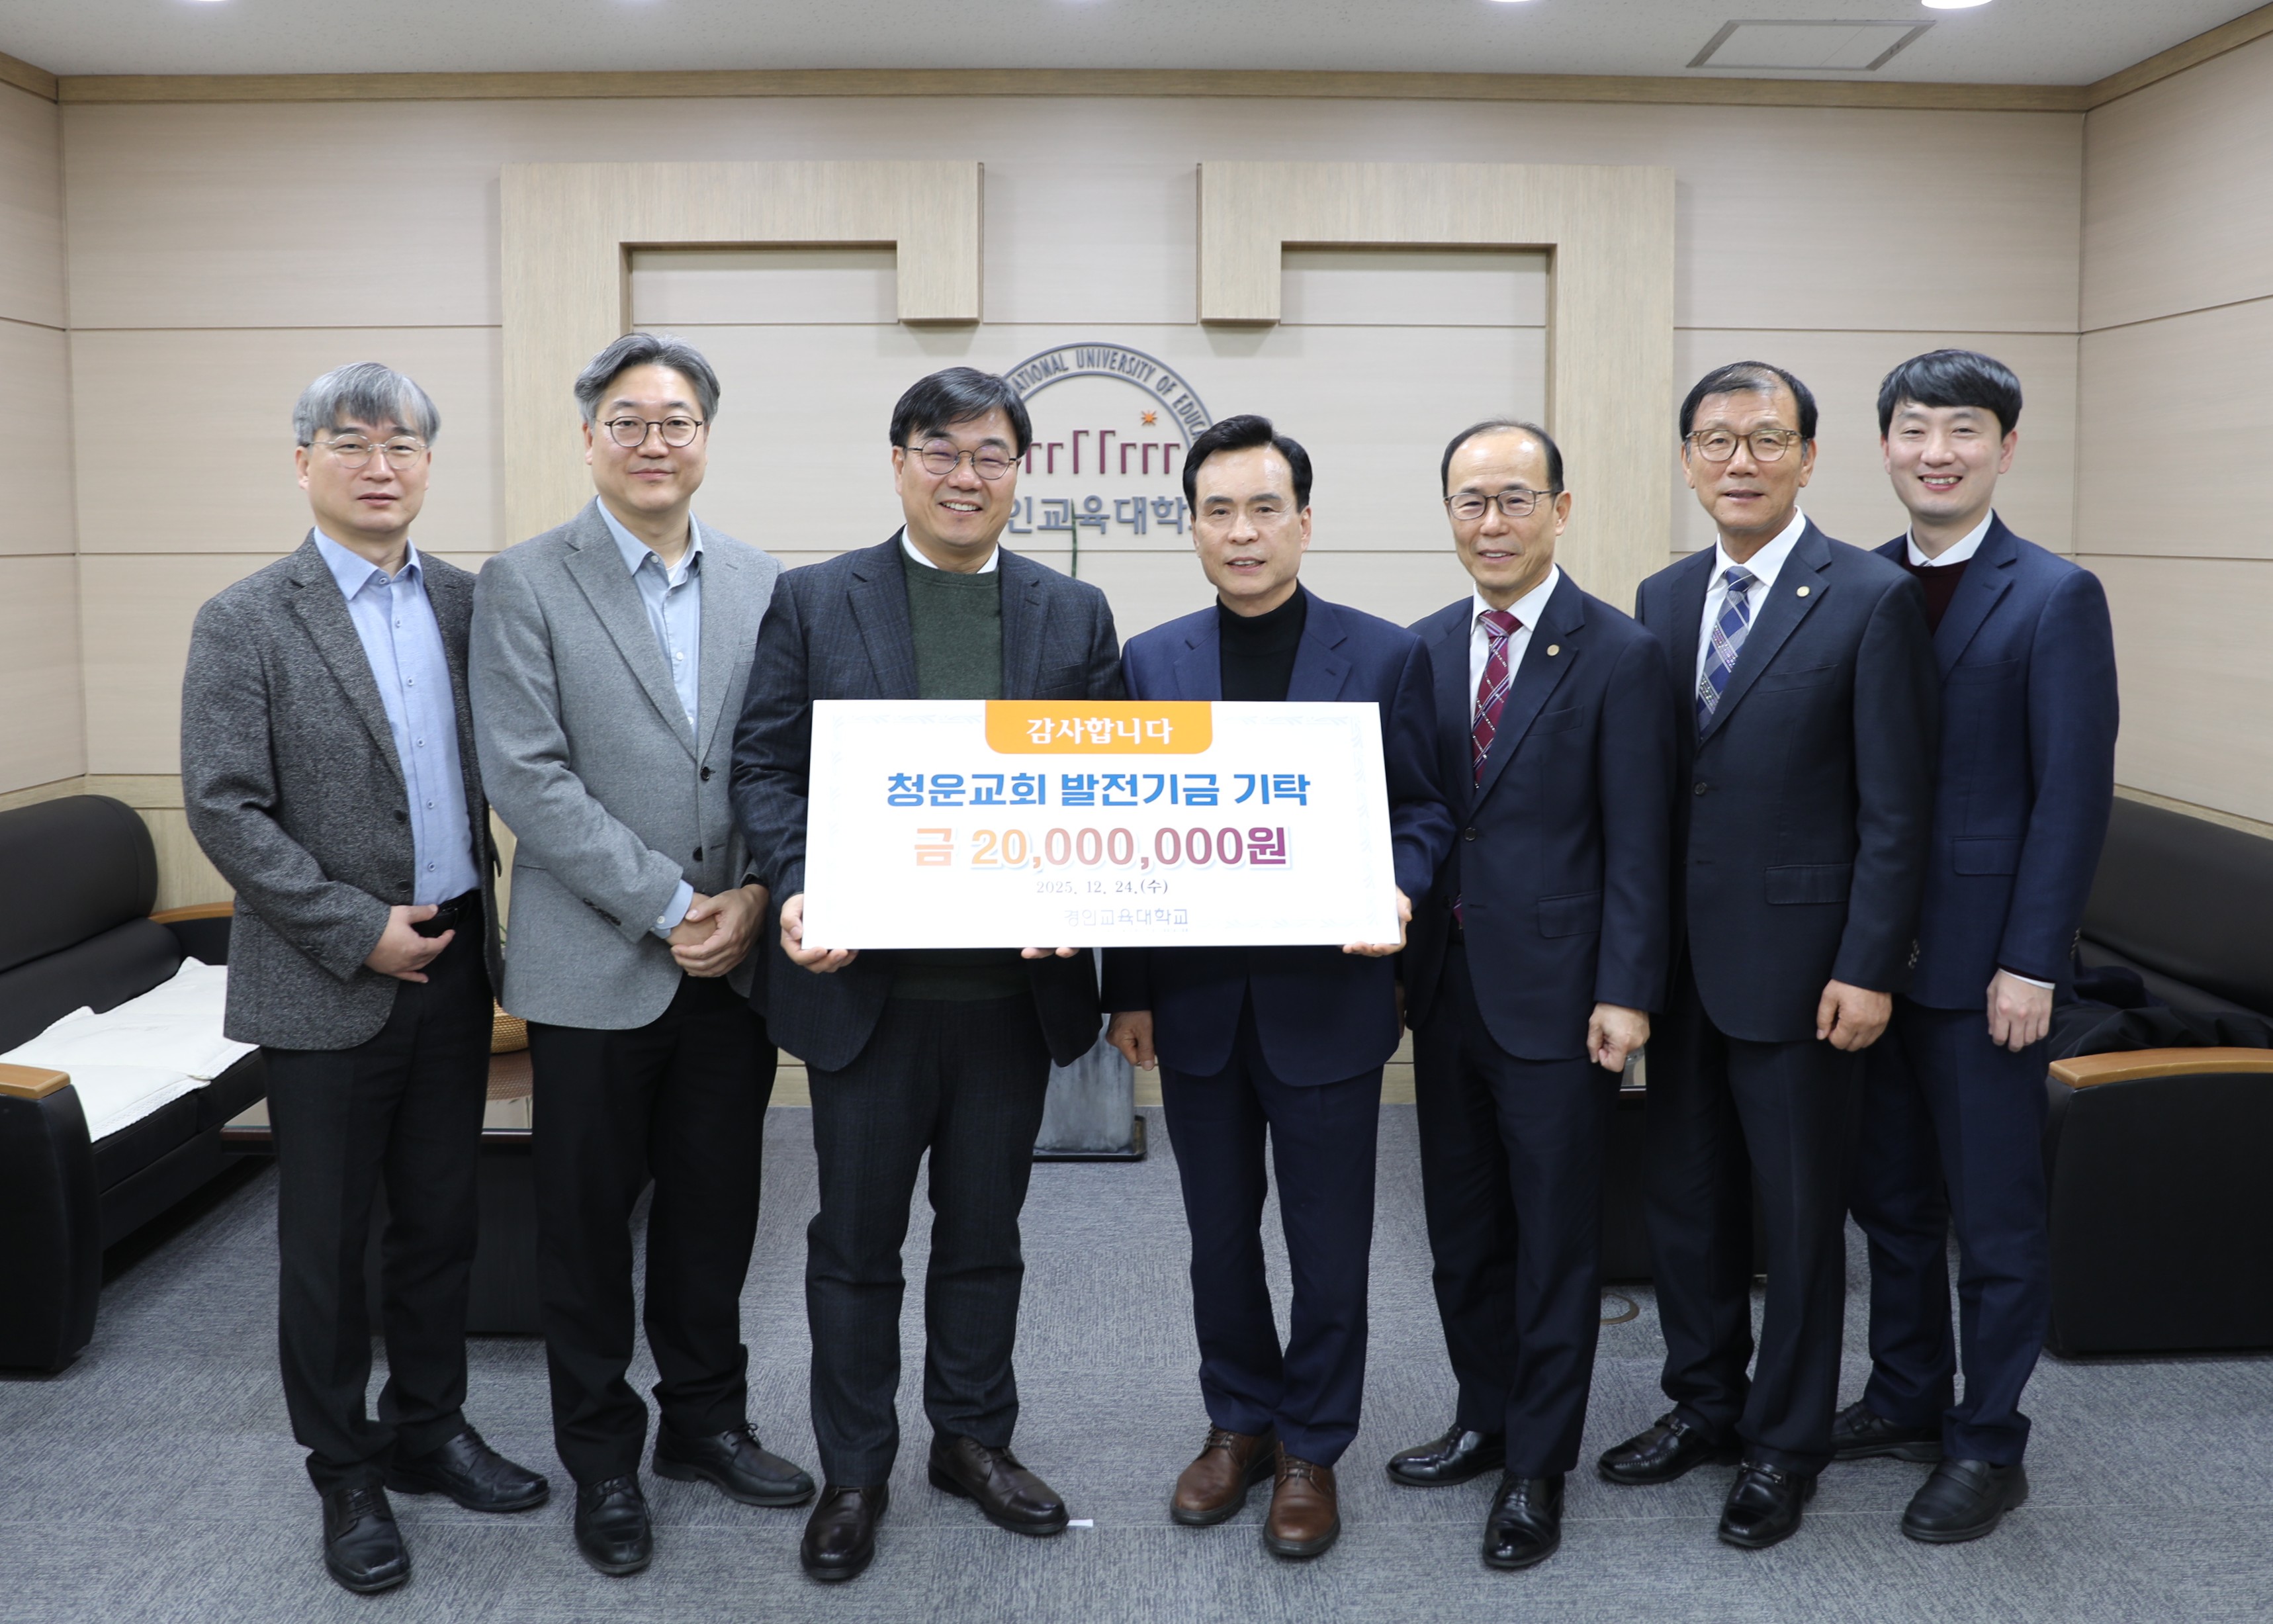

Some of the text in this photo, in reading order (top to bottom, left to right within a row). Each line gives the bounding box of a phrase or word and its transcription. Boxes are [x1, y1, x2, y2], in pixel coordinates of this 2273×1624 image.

[1011, 347, 1209, 441] ATIONAL UNIVERSITY OF EDUCA
[1006, 494, 1195, 535] 인교육대학
[1026, 717, 1174, 746] 감사합니다
[887, 772, 1312, 807] 청운교회 발전기금 기탁
[914, 827, 1288, 871] 금 20,000,000원
[1036, 879, 1169, 895] 2025. 12. 24.(수)
[1064, 907, 1189, 926] 경인교육대학교
